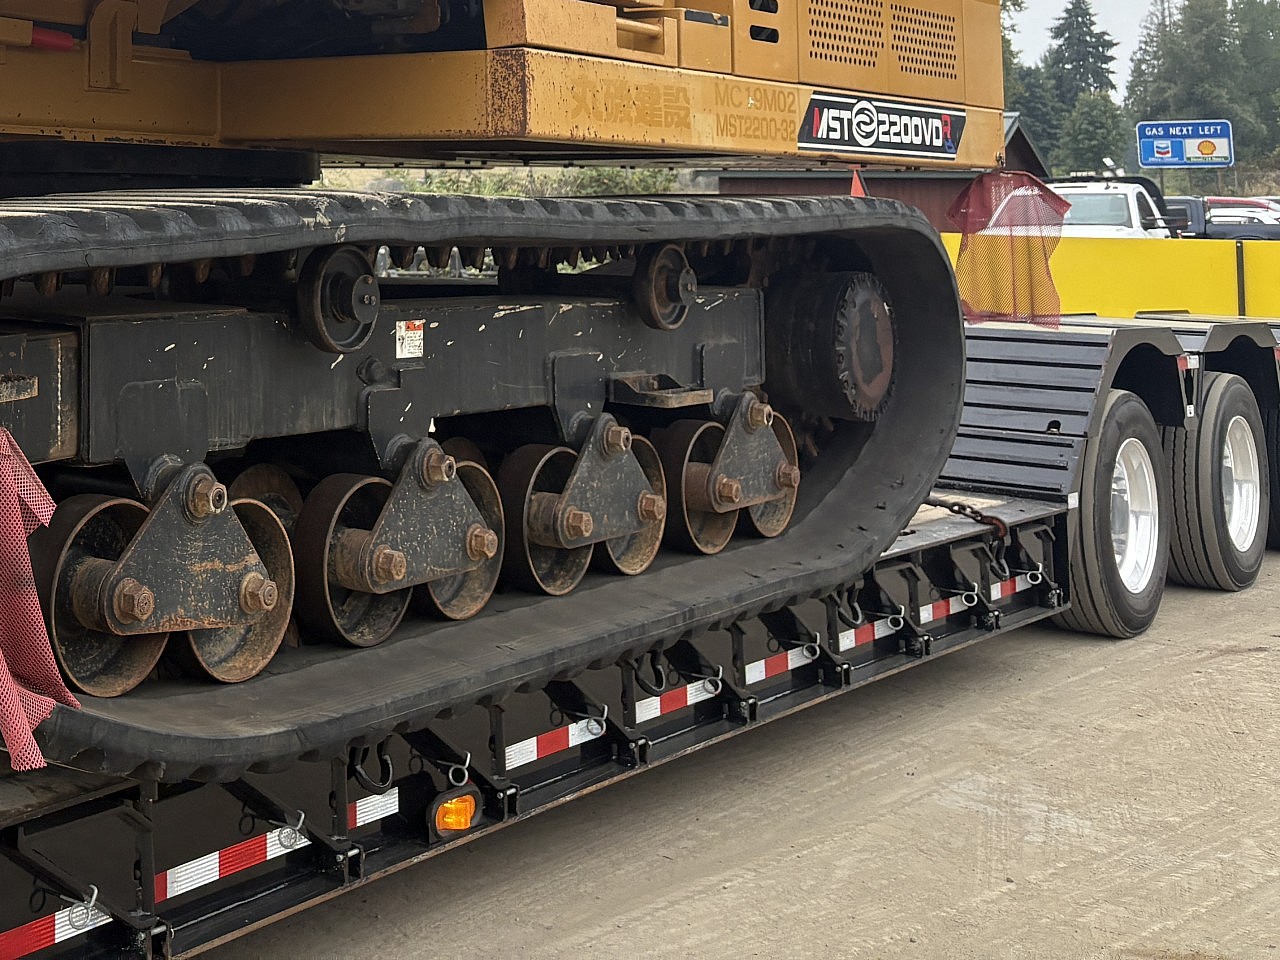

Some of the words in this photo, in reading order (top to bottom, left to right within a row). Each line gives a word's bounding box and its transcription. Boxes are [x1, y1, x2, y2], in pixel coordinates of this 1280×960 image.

[1145, 127, 1164, 136] GAS
[1169, 126, 1193, 136] NEXT
[1198, 125, 1222, 135] LEFT
